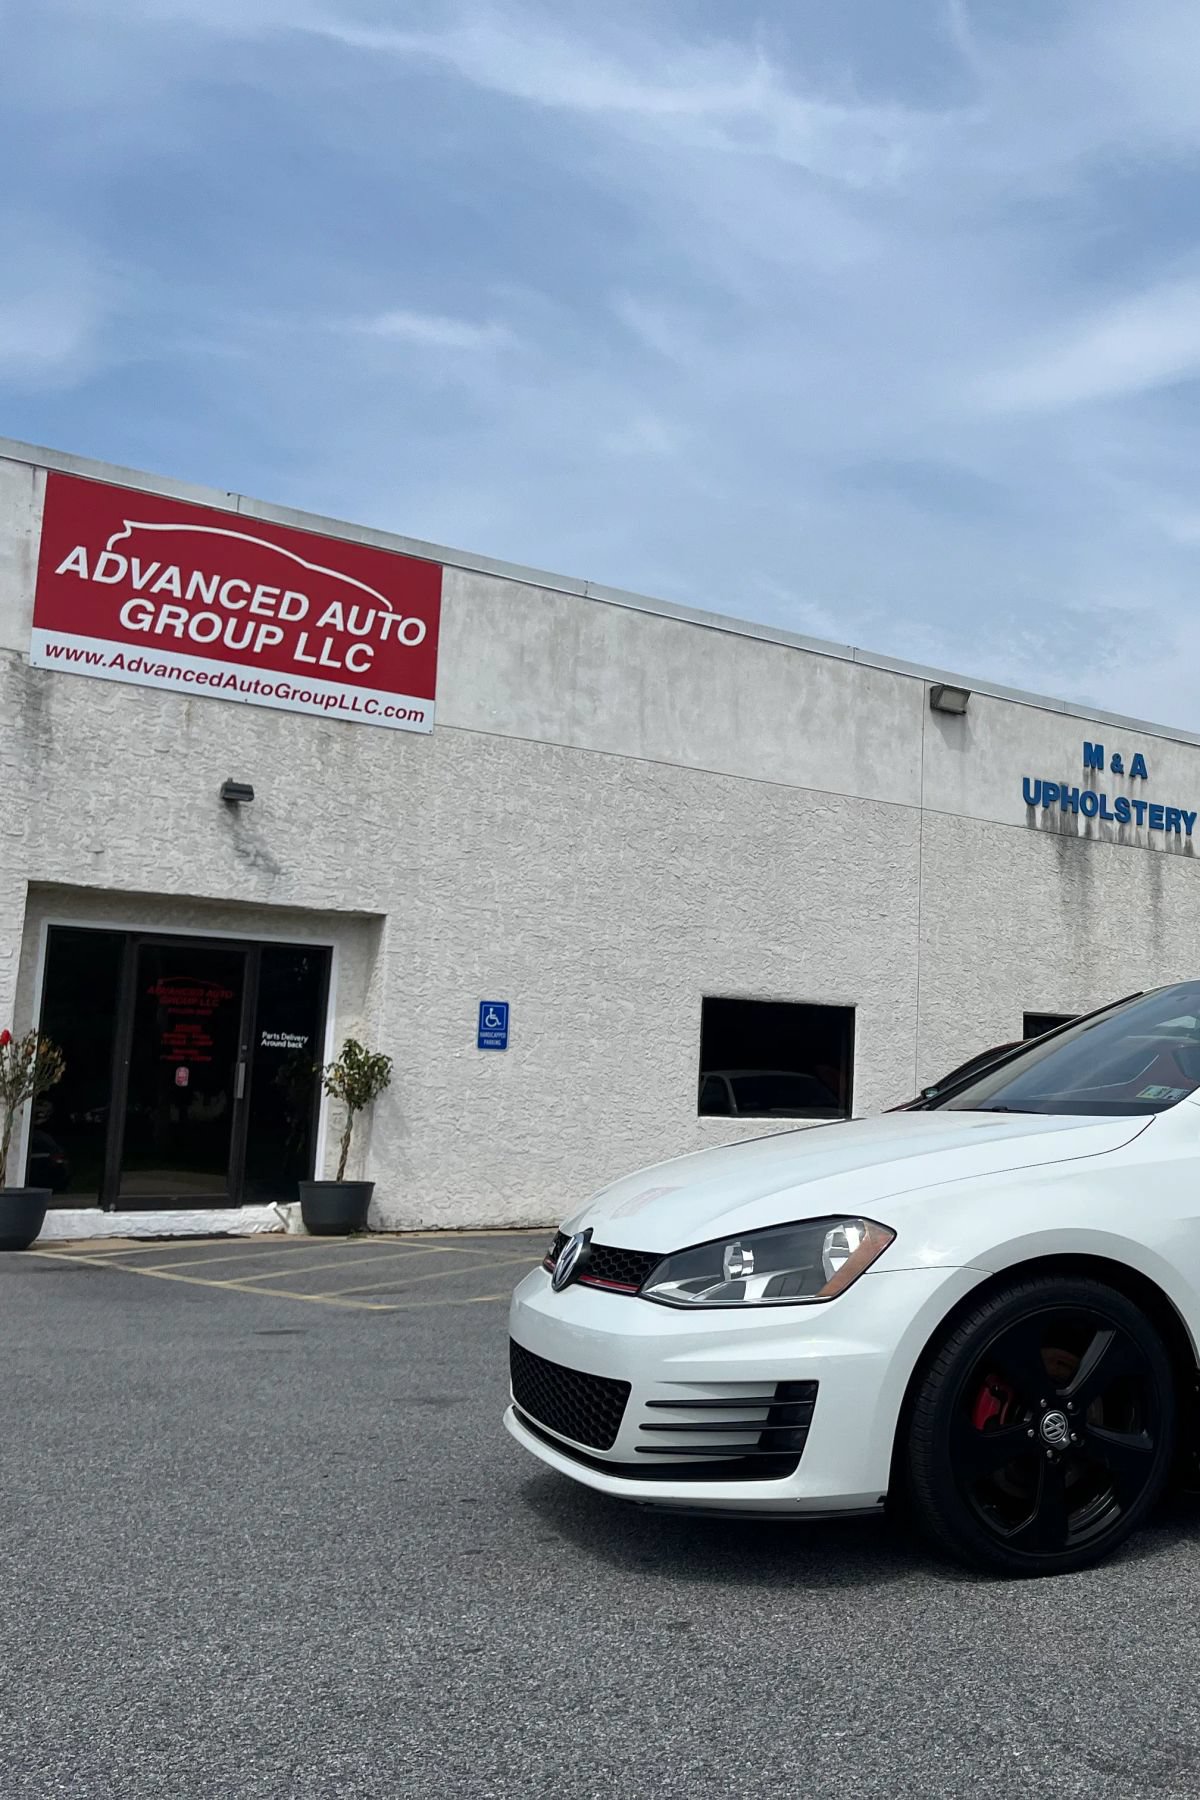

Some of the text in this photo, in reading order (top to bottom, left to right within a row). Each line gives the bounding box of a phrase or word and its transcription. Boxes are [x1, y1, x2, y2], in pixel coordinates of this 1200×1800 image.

[54, 545, 427, 648] ADVANCED AUTO
[119, 598, 375, 674] GROUP LLC
[44, 641, 426, 724] www.AdvancedAutoGroupLLC.com
[1083, 741, 1148, 780] M & A
[1022, 777, 1198, 836] UPHOLSTERY
[260, 1039, 303, 1048] Around back
[262, 1031, 309, 1044] Parts Delivery
